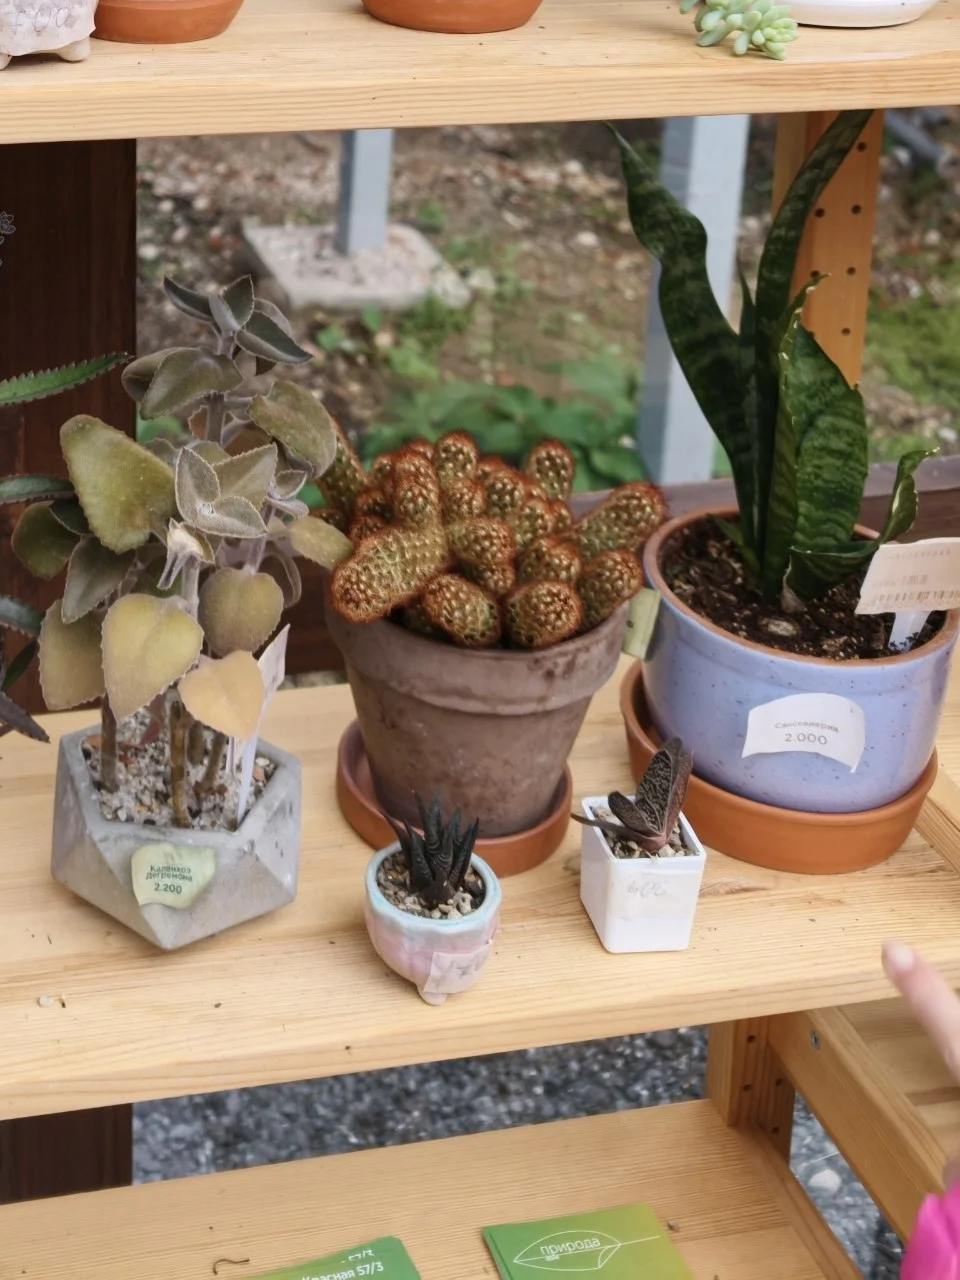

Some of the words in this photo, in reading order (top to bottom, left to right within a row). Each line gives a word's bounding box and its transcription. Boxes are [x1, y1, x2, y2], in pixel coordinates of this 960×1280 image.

[784, 732, 827, 745] 2.000
[540, 1237, 601, 1257] природа
[356, 1261, 385, 1276] 57/3
